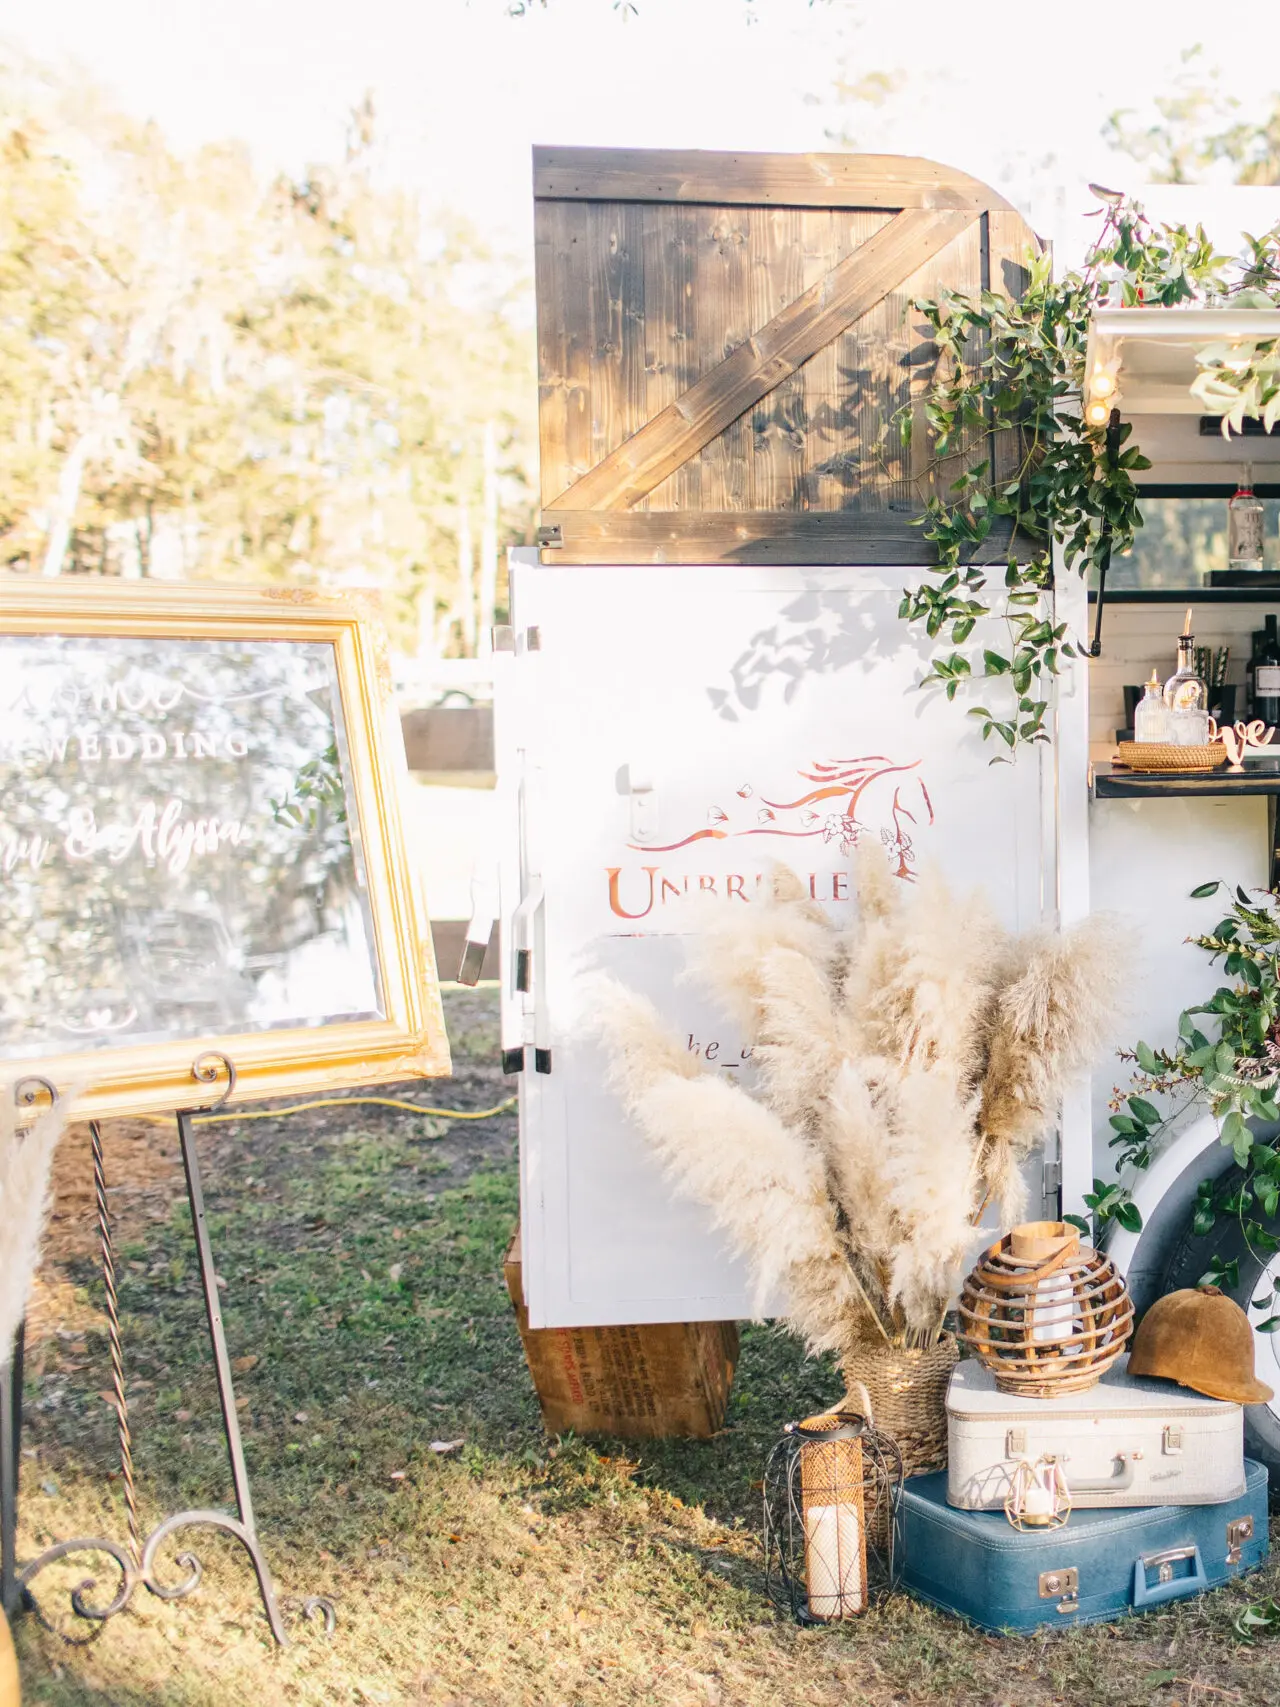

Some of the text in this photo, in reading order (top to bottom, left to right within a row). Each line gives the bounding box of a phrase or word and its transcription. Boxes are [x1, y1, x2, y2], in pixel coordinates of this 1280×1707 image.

[44, 732, 248, 763] WEDDING
[108, 800, 249, 874] Alyssa
[604, 866, 863, 919] UNBRLE
